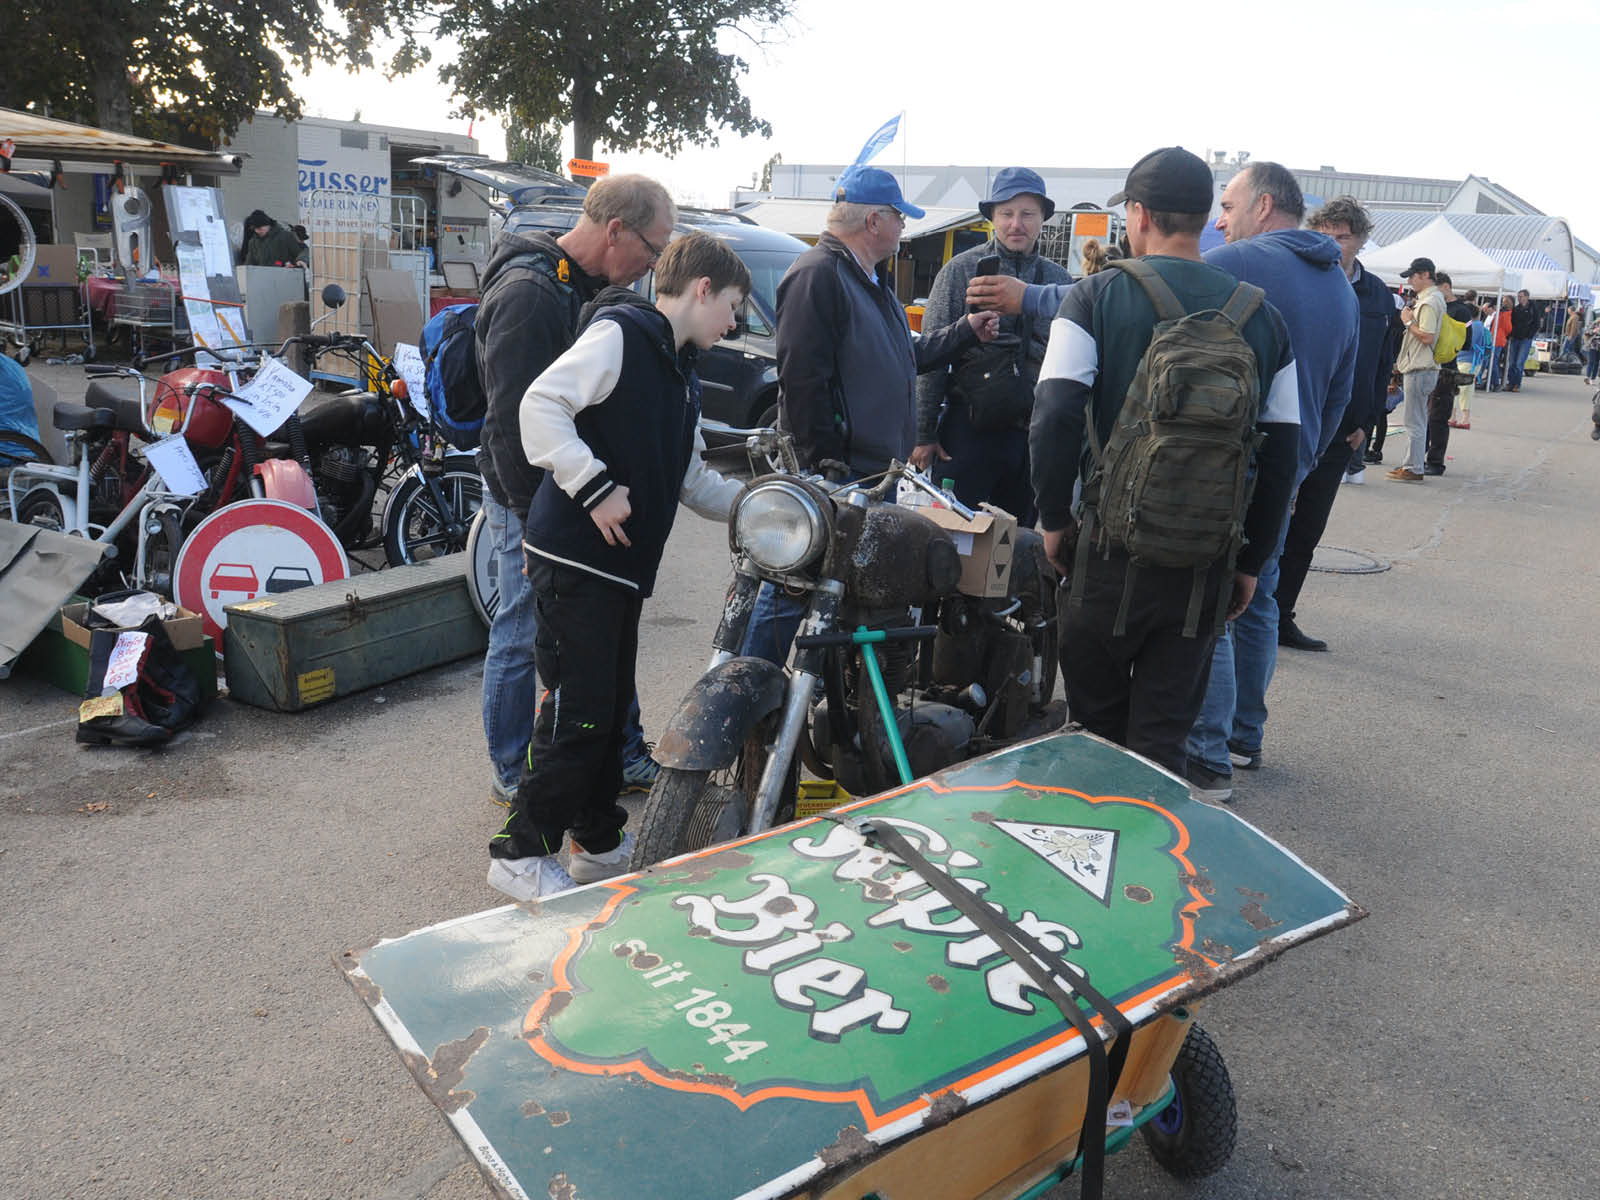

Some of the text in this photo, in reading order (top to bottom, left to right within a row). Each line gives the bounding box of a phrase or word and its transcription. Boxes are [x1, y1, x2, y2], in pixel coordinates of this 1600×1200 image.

[297, 158, 388, 195] eusser
[673, 872, 911, 1042] Bier
[673, 986, 768, 1064] 1844
